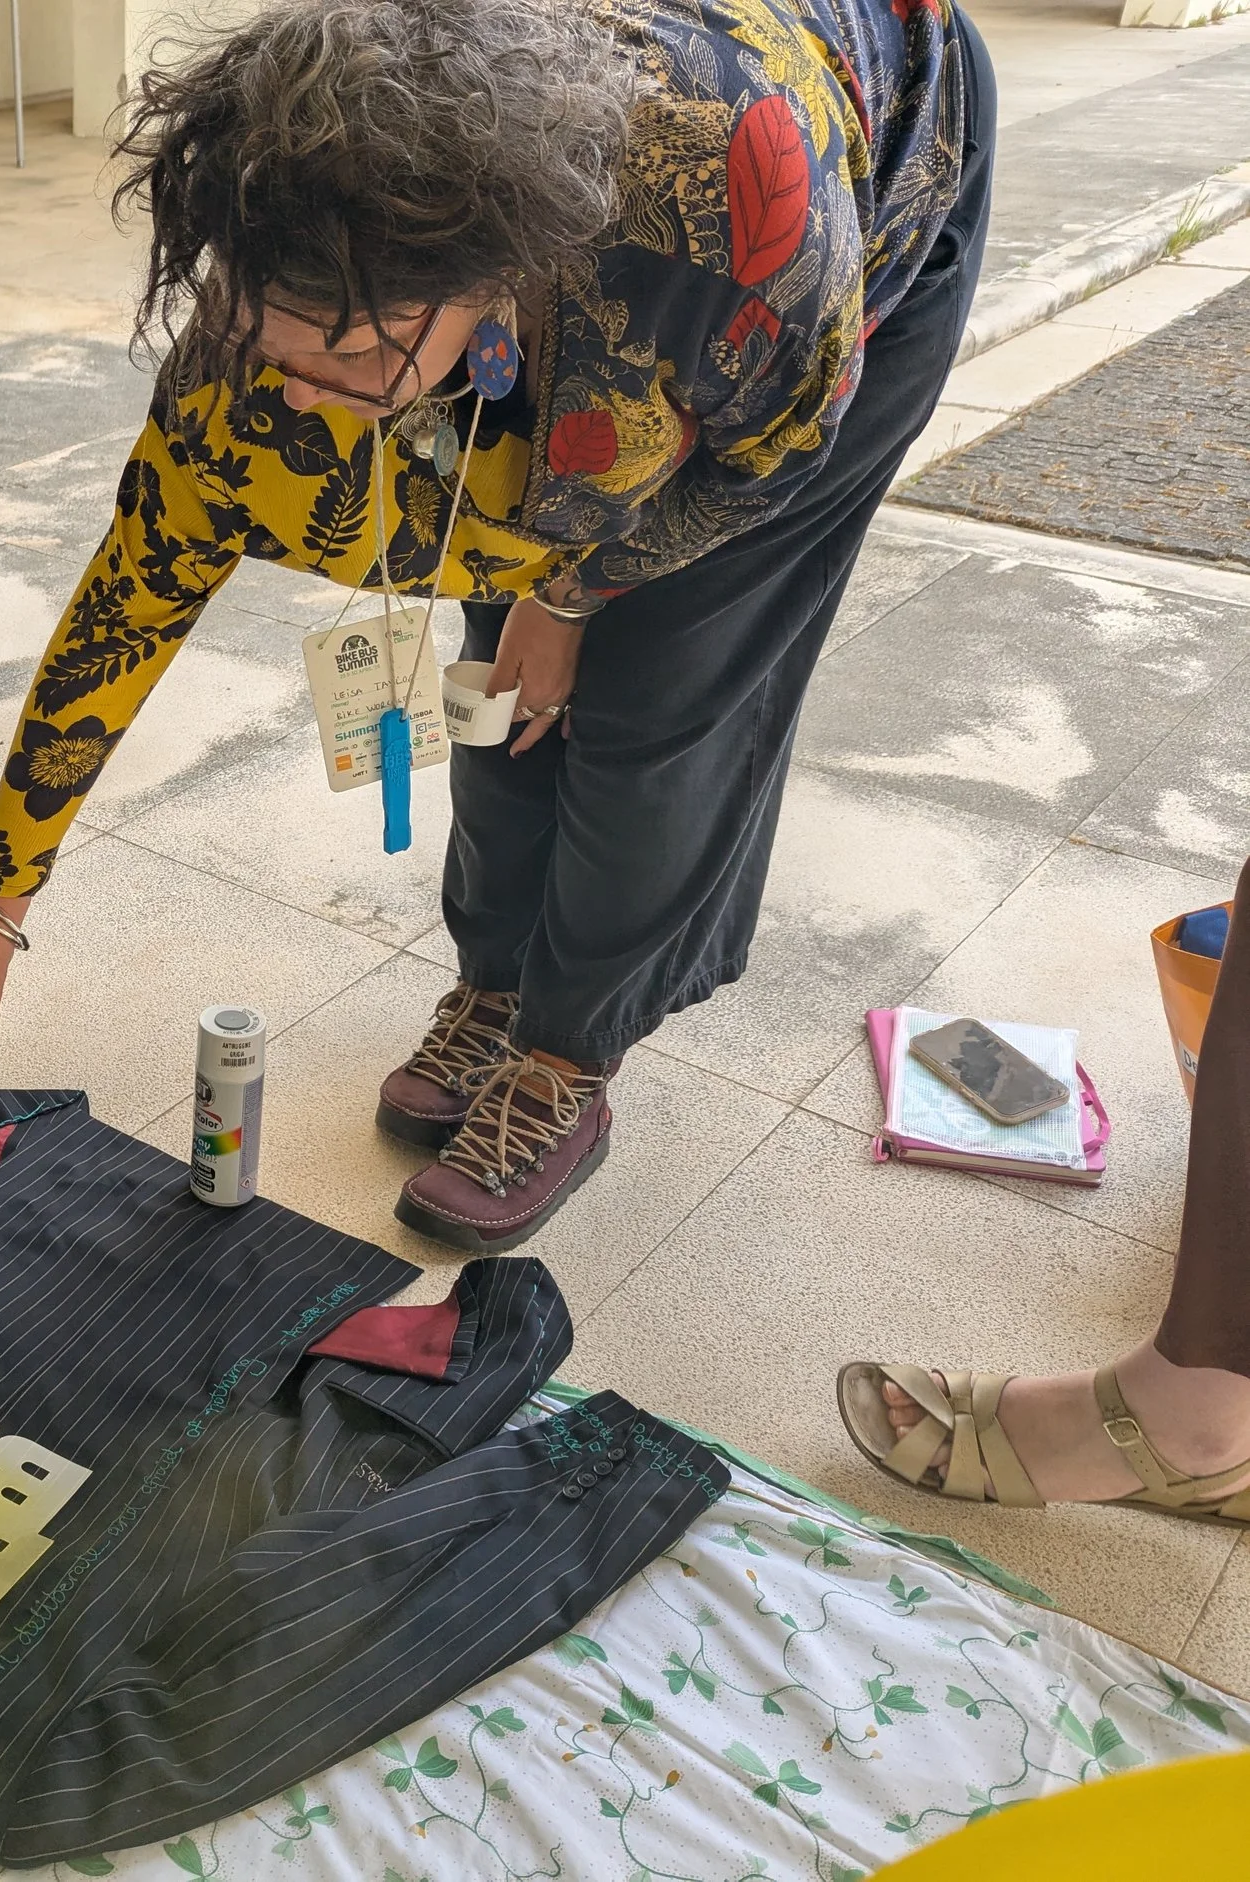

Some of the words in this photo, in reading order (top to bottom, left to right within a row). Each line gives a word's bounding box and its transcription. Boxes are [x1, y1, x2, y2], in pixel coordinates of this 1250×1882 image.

[335, 652, 358, 665] BIKE
[358, 645, 378, 658] BUS
[337, 654, 379, 673] SUMMIT
[334, 723, 381, 741] SHIMAN
